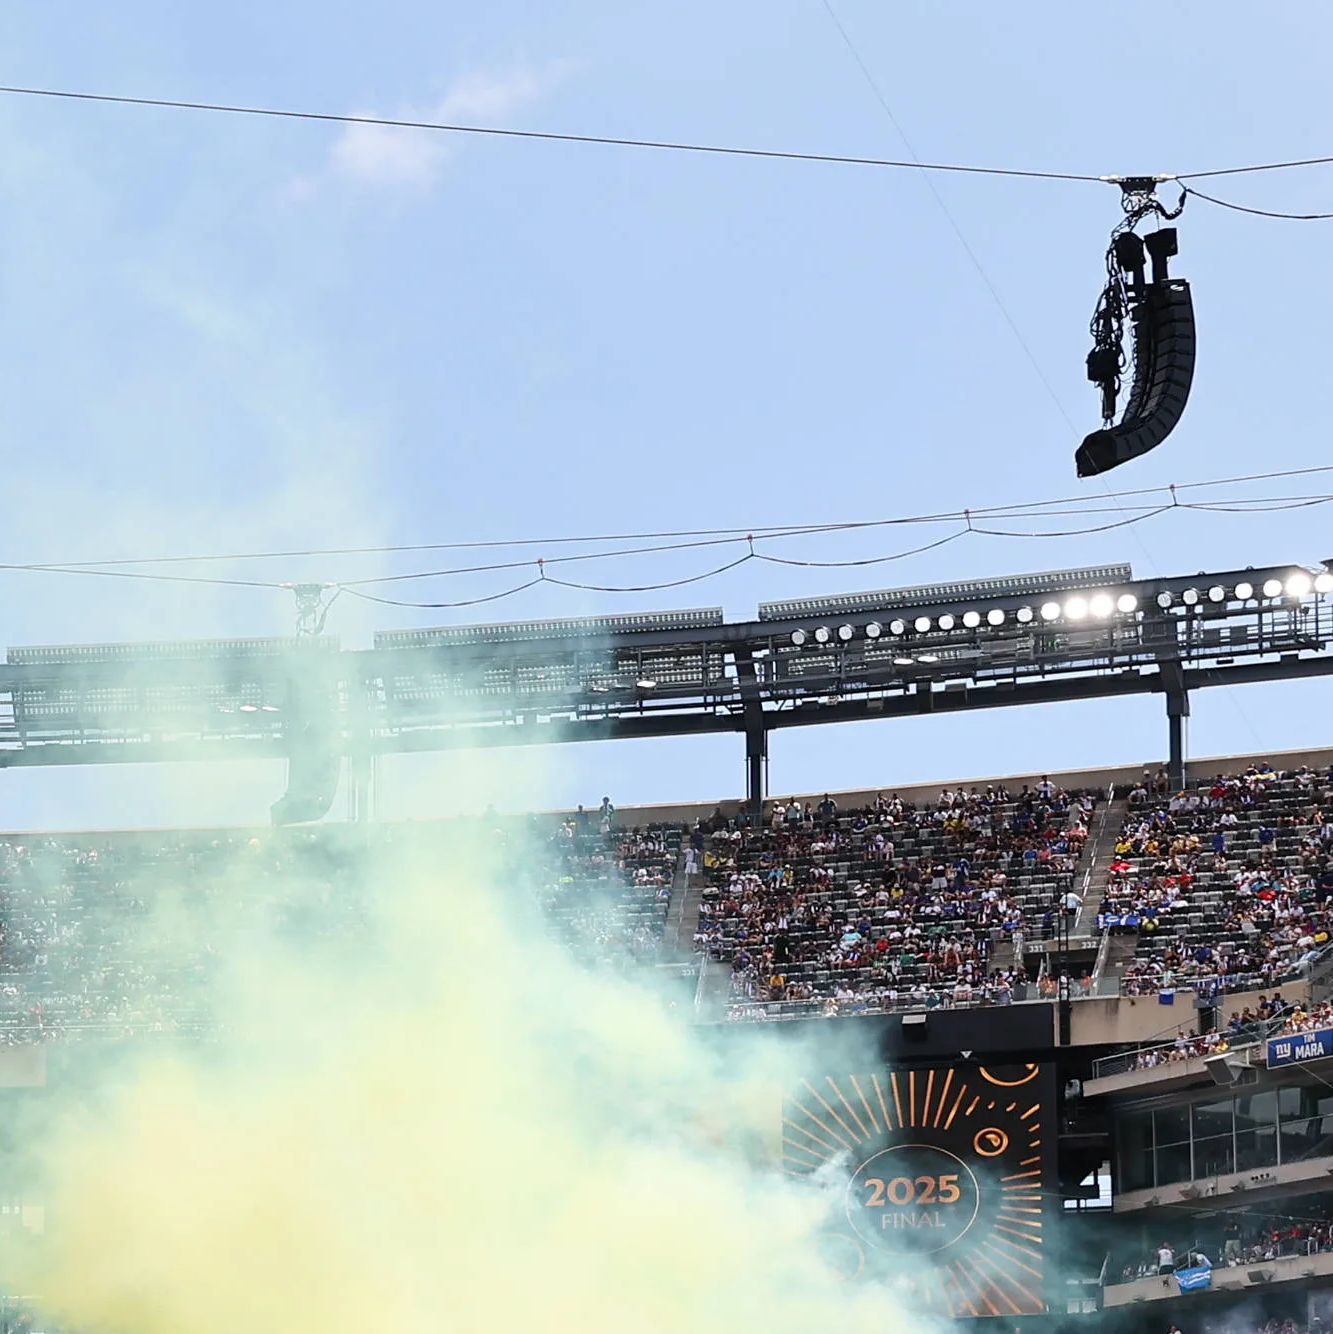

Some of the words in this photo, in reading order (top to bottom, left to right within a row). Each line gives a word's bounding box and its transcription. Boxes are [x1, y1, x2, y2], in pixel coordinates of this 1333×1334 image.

[1303, 1033, 1317, 1044] TIM
[1295, 1042, 1325, 1060] MARA
[864, 1174, 961, 1207] 2025
[881, 1211, 947, 1230] FINAL
